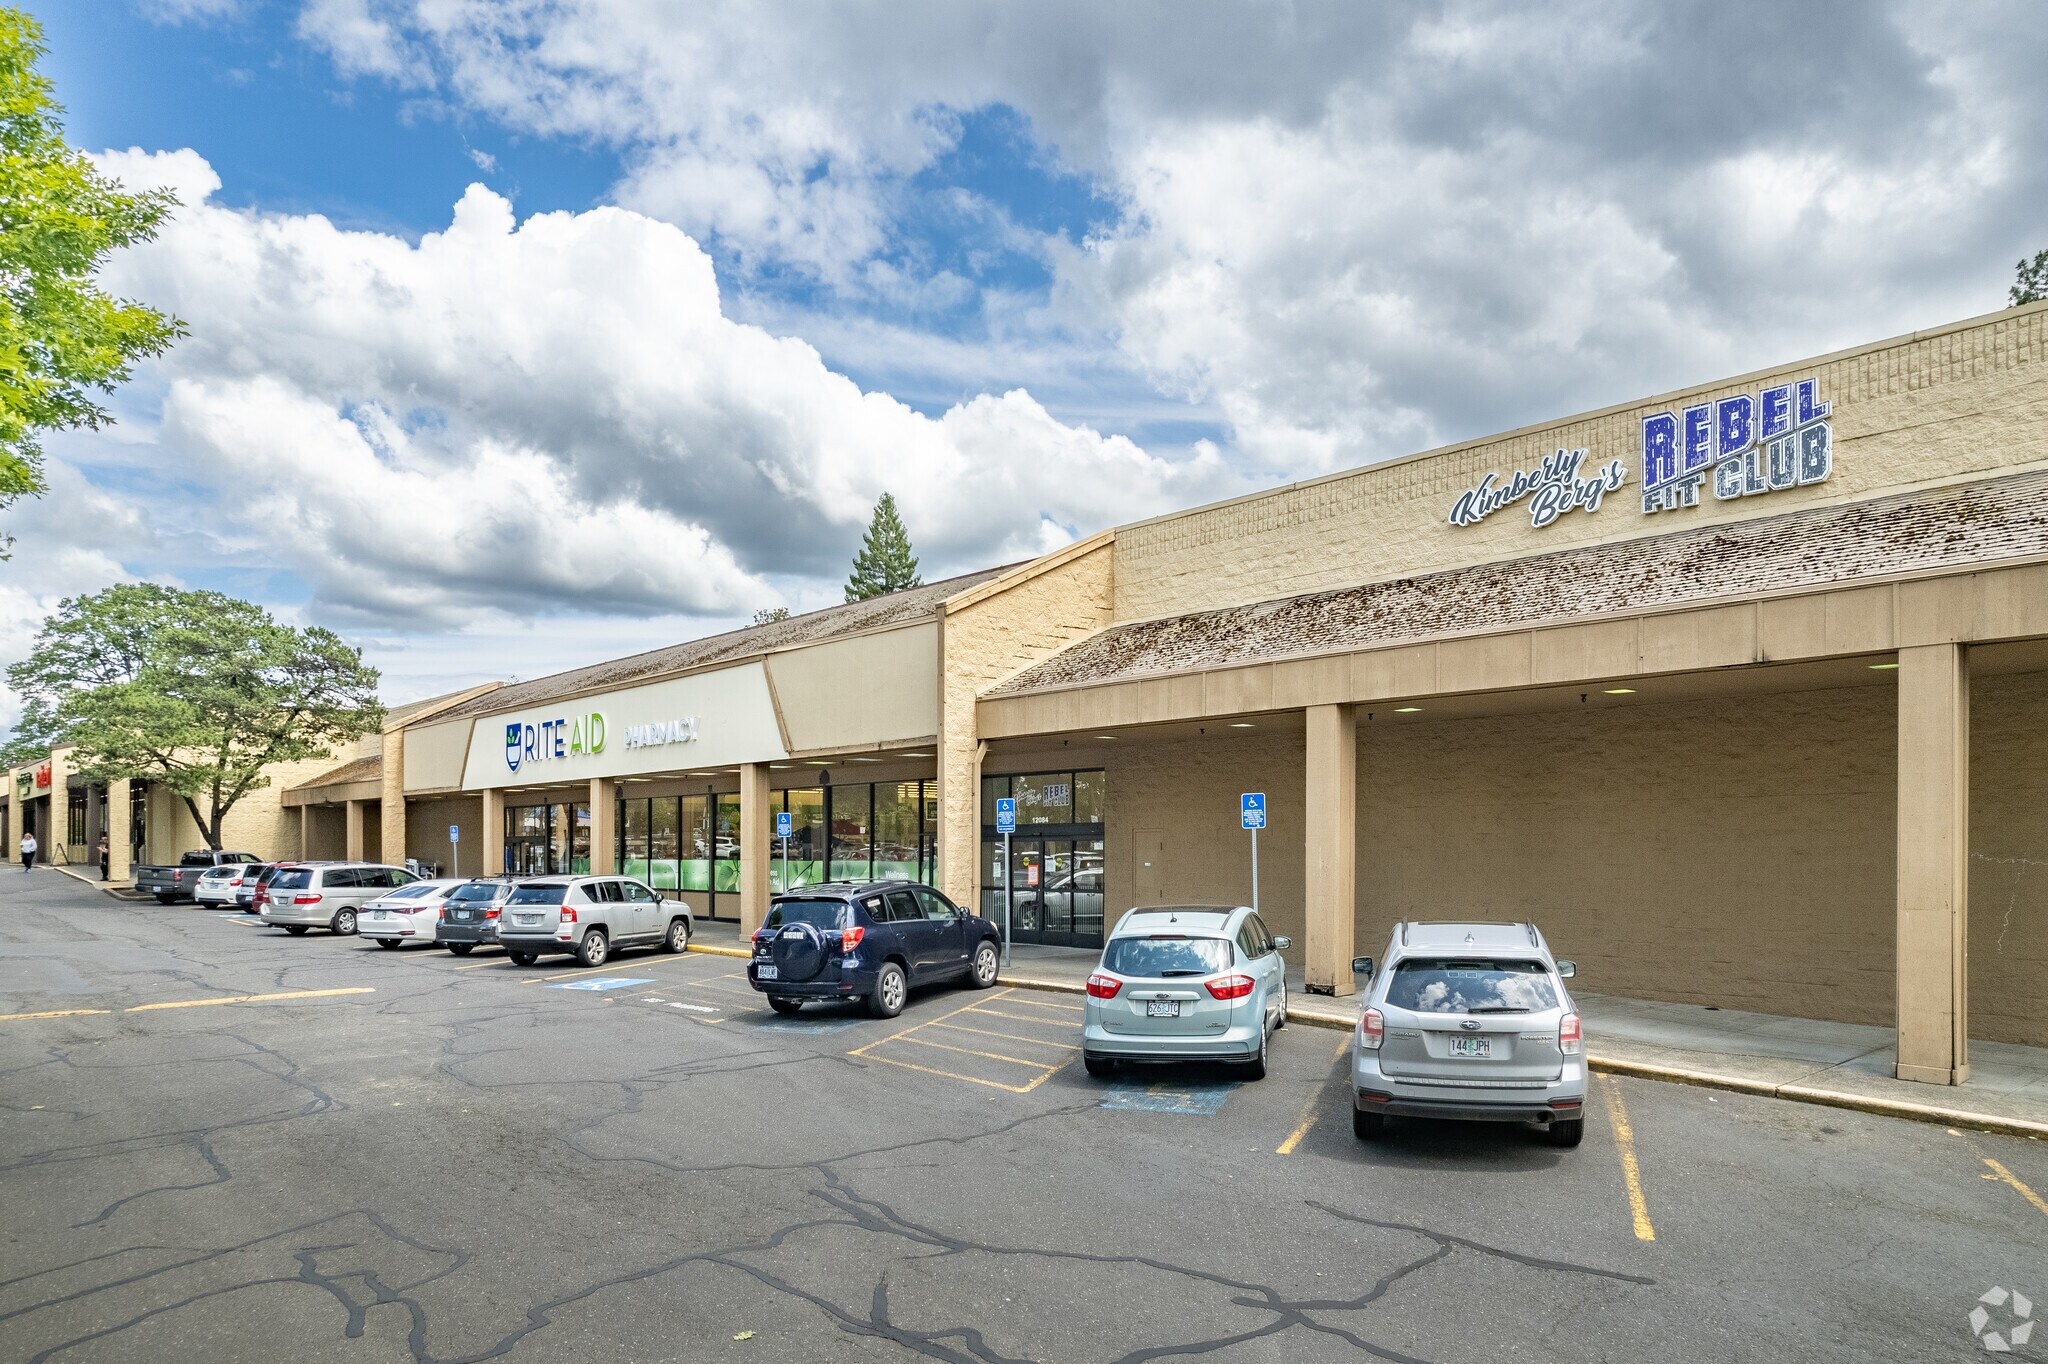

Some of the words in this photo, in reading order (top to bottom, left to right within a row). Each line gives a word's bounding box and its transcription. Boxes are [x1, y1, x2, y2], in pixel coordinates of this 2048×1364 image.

[1642, 378, 1832, 494] REBEL
[1450, 449, 1587, 526] Kimberly
[1642, 471, 1706, 514] FIT
[1714, 420, 1832, 501] CLUB
[1530, 460, 1627, 527] Berg's
[525, 719, 568, 762] RITE
[570, 713, 608, 756] AID
[623, 716, 700, 750] PHARMACY
[1043, 784, 1070, 801] REBEL
[1032, 816, 1049, 824] 12084
[885, 870, 909, 880] Wellness
[1451, 1039, 1467, 1051] 144
[1473, 1039, 1491, 1052] JPH
